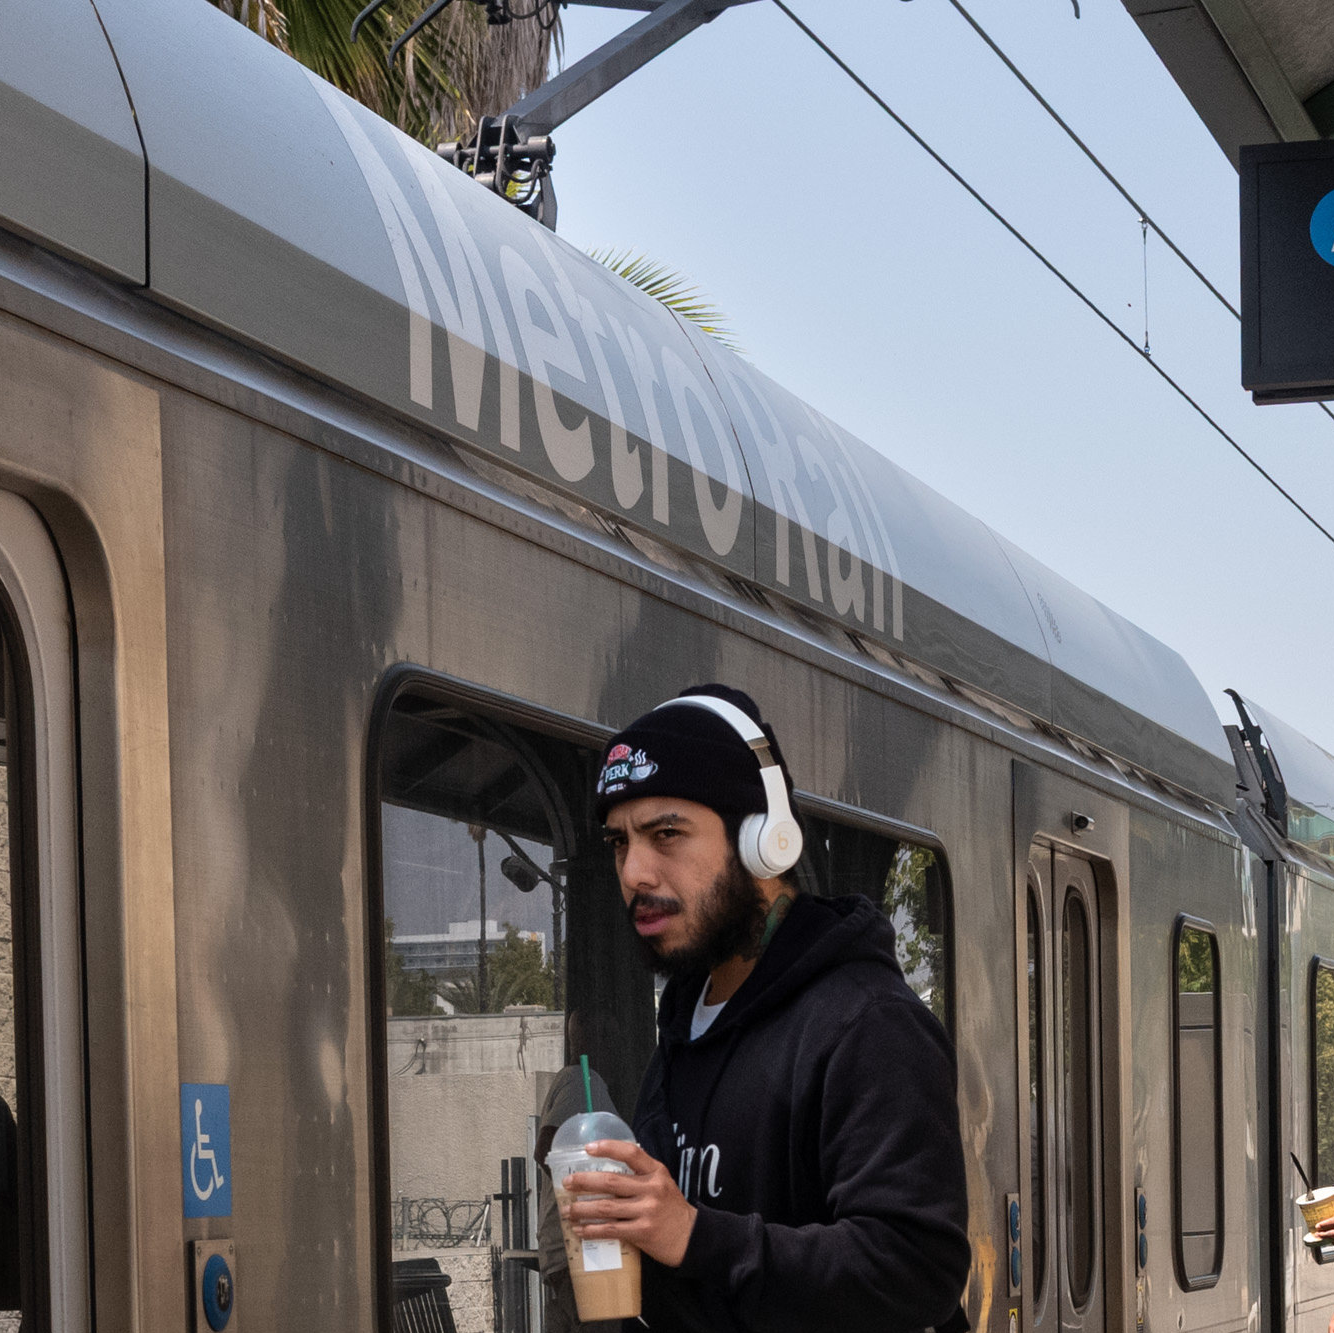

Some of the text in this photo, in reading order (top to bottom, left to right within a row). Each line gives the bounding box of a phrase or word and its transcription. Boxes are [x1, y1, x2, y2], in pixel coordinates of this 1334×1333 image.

[299, 66, 905, 642] Metro Rail
[605, 763, 630, 783] PERK
